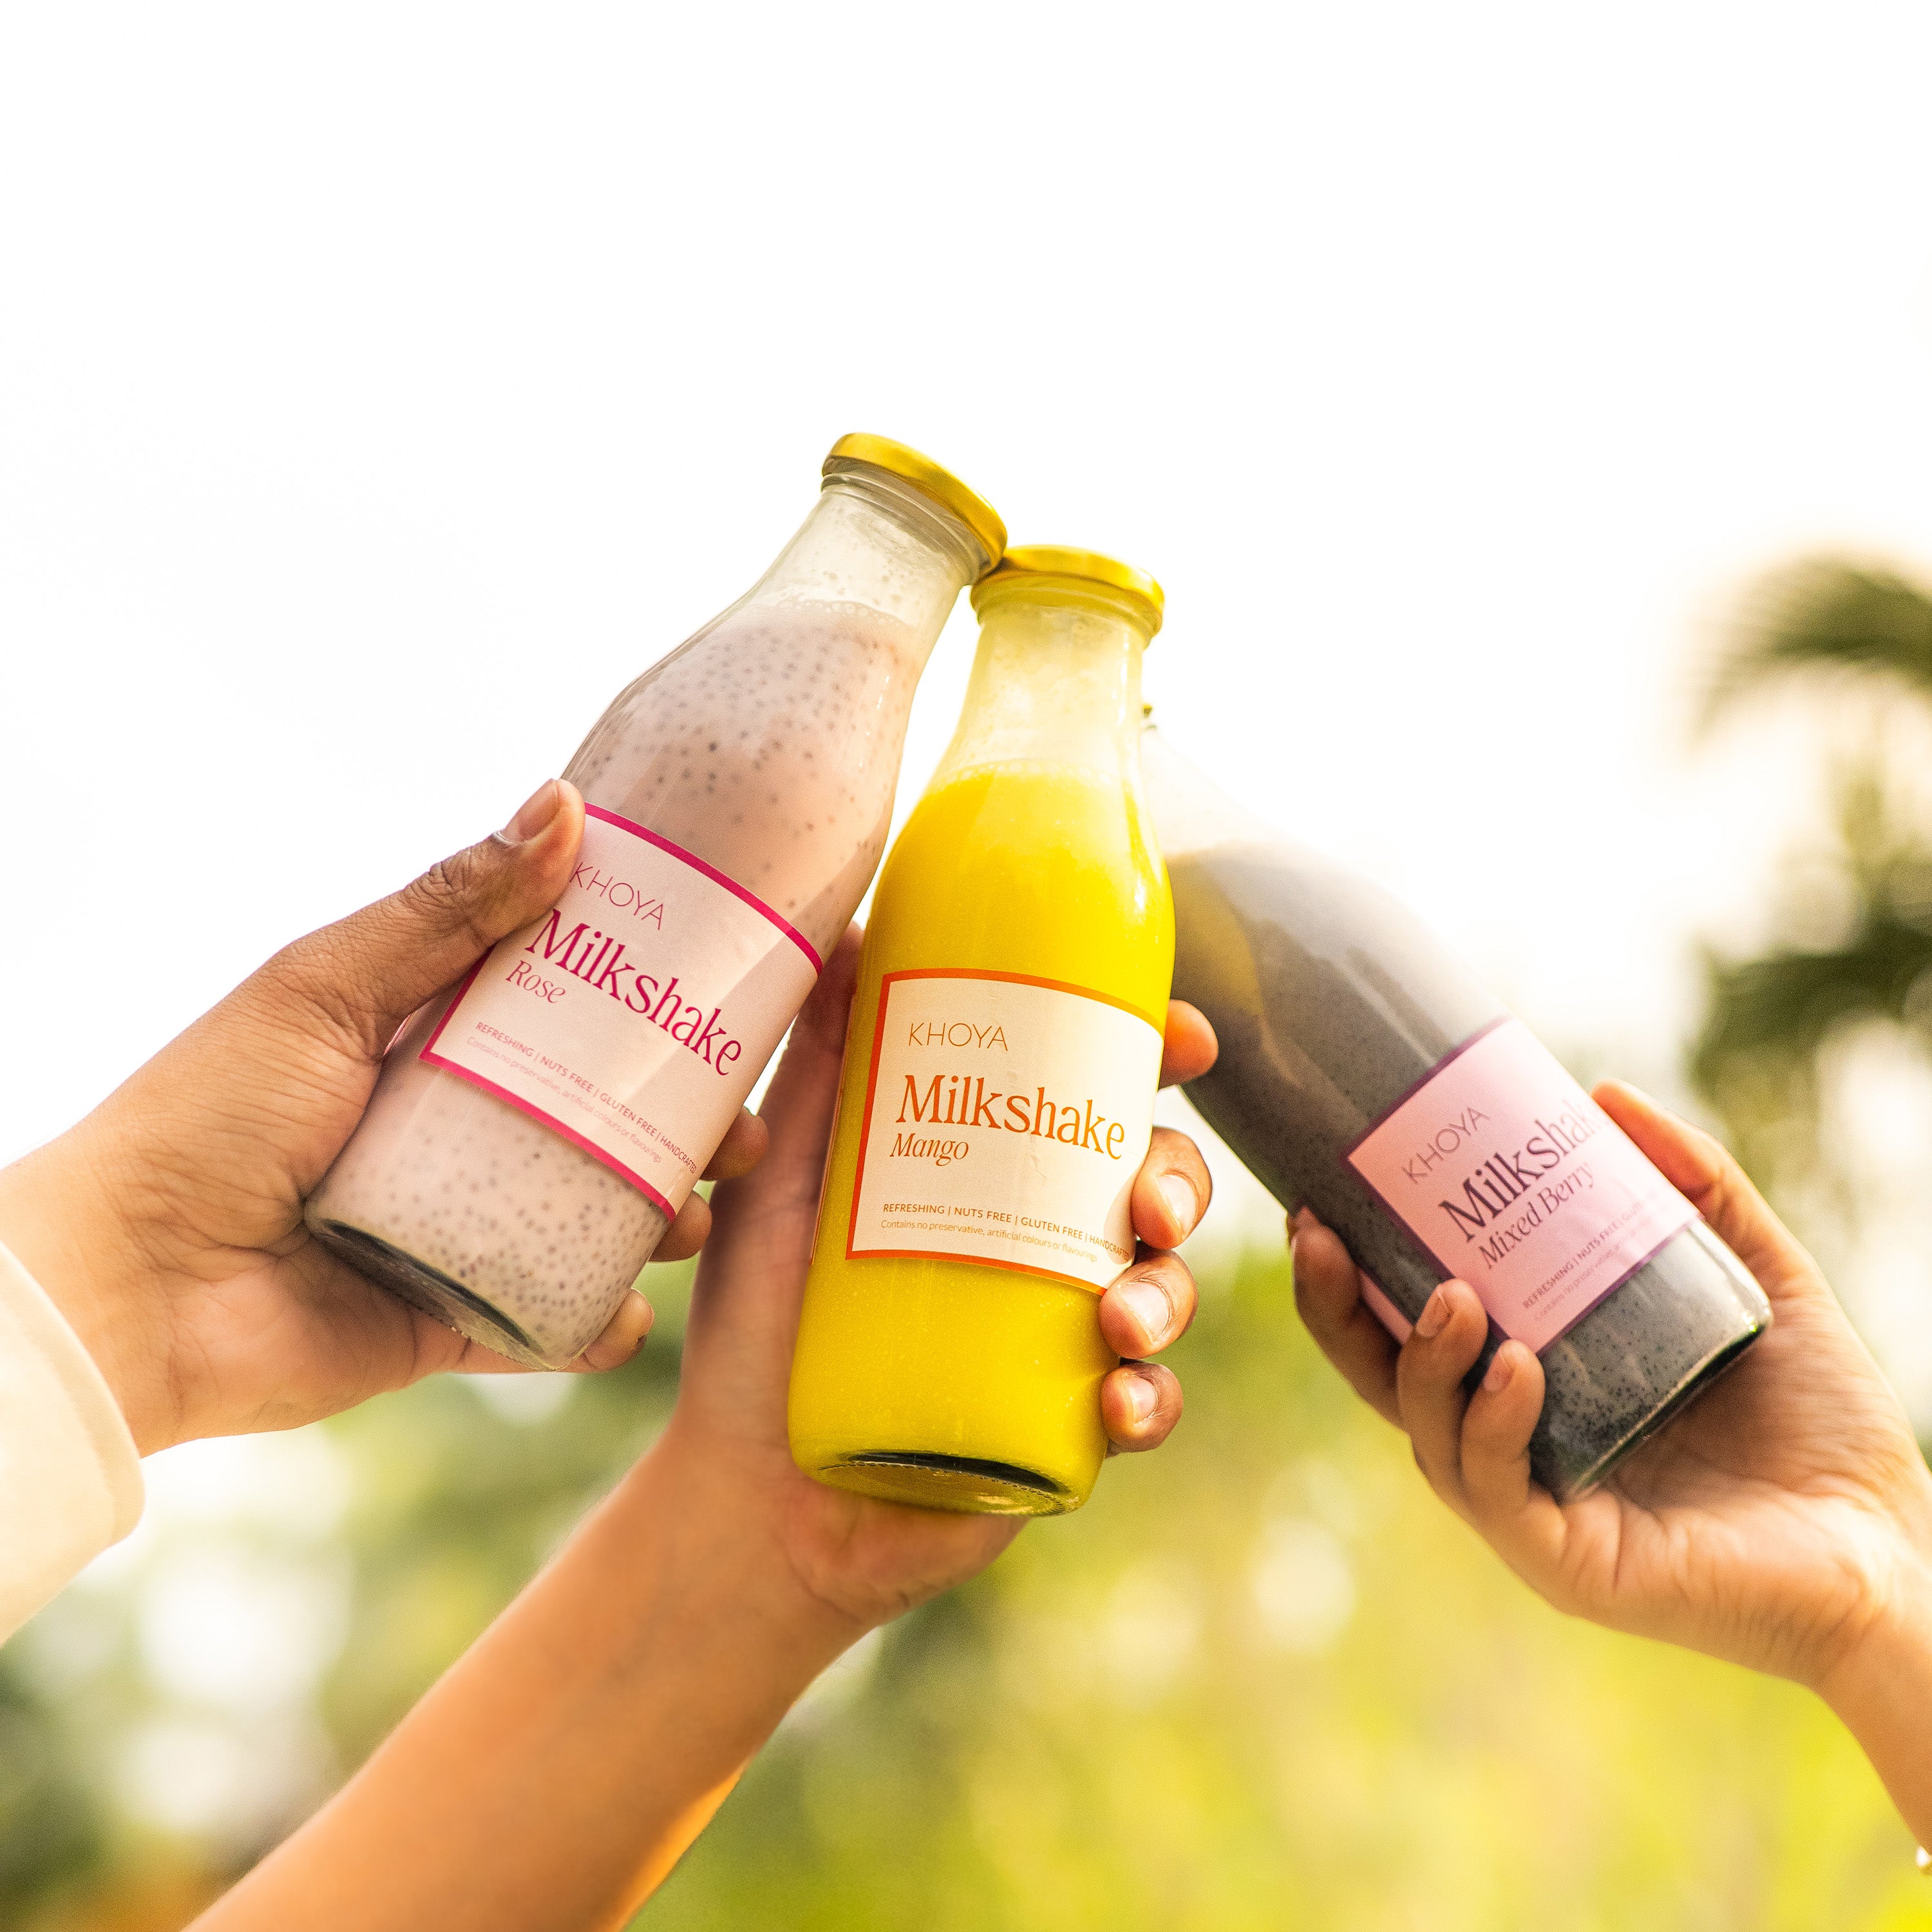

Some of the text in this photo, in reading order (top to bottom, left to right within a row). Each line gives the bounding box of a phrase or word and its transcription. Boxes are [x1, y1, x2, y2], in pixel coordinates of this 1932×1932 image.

[569, 861, 664, 930] KHOYA
[506, 960, 566, 1003] Rose
[524, 908, 742, 1076] Milkshake
[907, 1022, 1009, 1052] KHOYA
[475, 1021, 697, 1174] REFRESHING NUTS FREE GLUTEN FREE HANDCRAFTED
[895, 1074, 1126, 1160] Milkshake
[889, 1132, 969, 1166] Mango
[1401, 1106, 1491, 1184] KHOYA
[881, 1220, 916, 1229] Contains
[987, 1228, 1021, 1241] artificial
[1022, 1234, 1052, 1247] colours
[1052, 1241, 1061, 1249] or
[1062, 1243, 1097, 1263] flavourings
[883, 1203, 945, 1214] REFRESHING
[954, 1207, 983, 1218] NUTS
[987, 1211, 1012, 1223] FREE
[1021, 1217, 1060, 1233] GLUTEN
[1063, 1226, 1083, 1240] FREE
[1478, 1201, 1543, 1270] Mixed
[1537, 1161, 1595, 1215] Berry
[1522, 1260, 1575, 1309] REFRESHING
